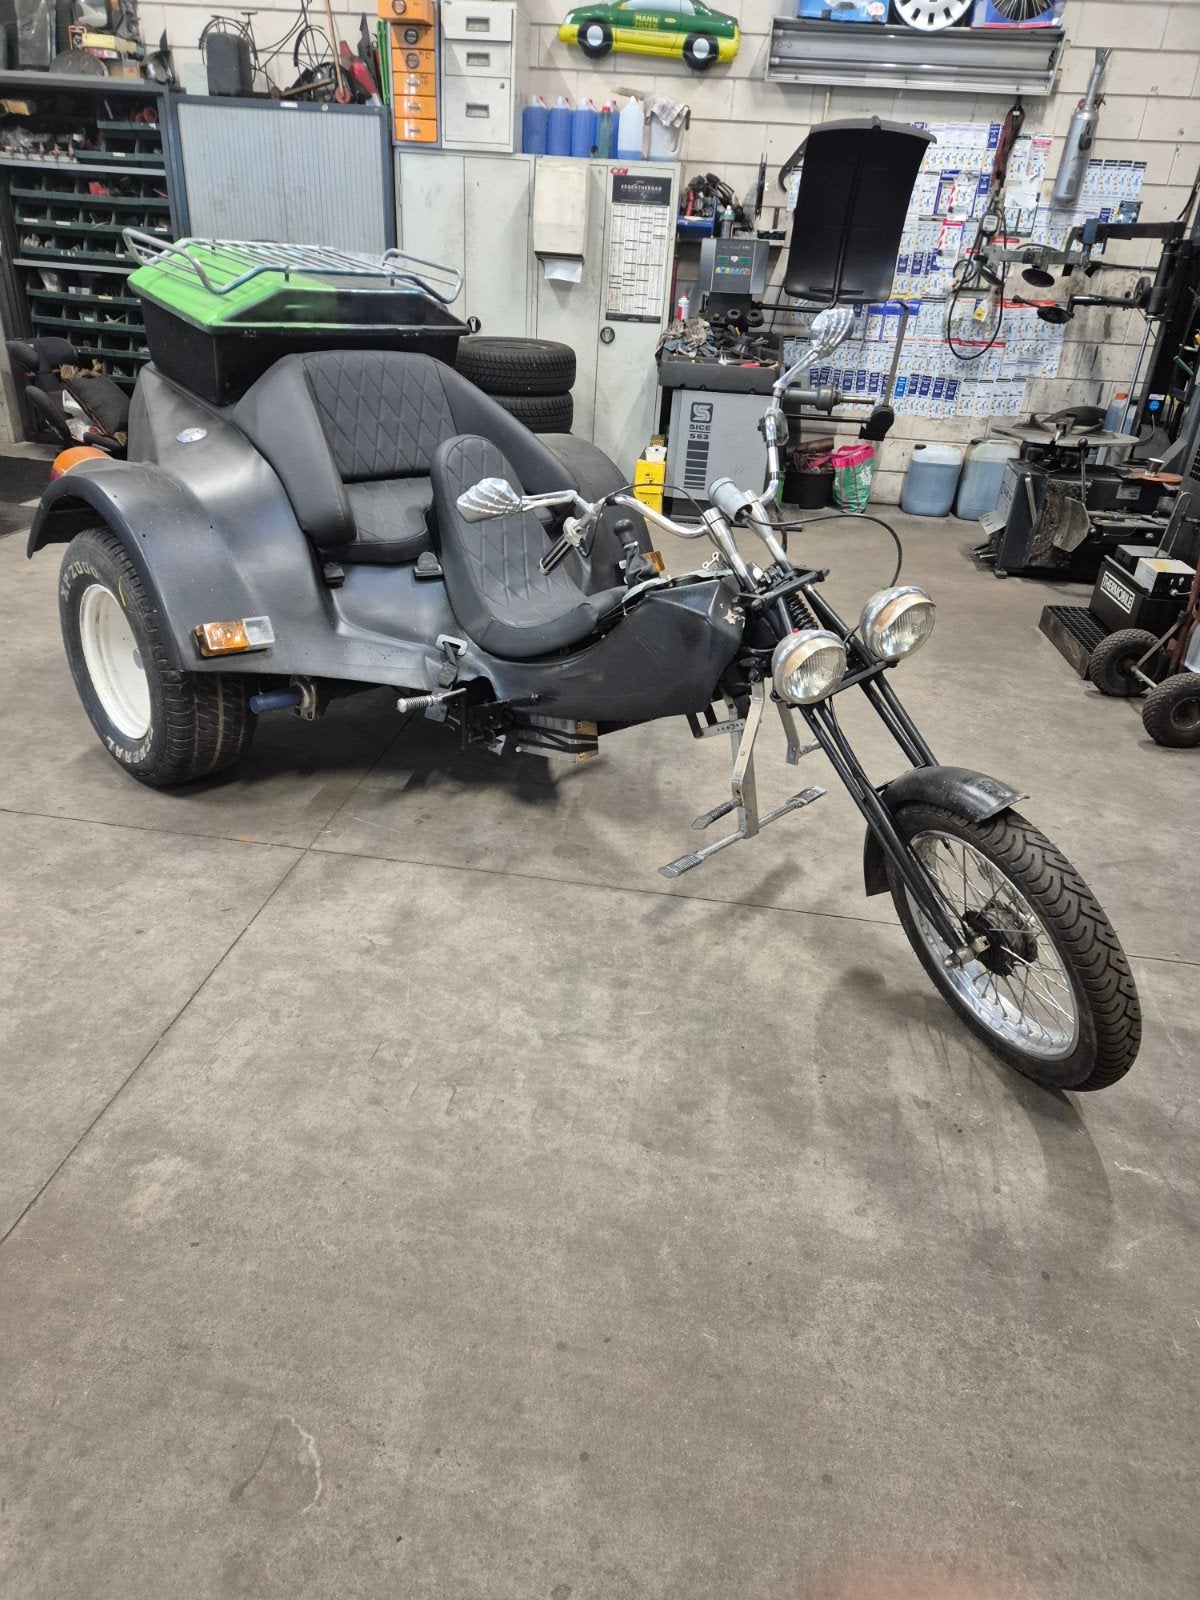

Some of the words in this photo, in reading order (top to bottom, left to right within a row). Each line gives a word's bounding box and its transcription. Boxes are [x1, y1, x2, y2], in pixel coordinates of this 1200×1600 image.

[635, 14, 659, 24] MANN
[635, 21, 658, 30] FILTER
[60, 573, 72, 603] XP
[68, 561, 100, 580] 2000
[106, 725, 154, 764] GENERAL
